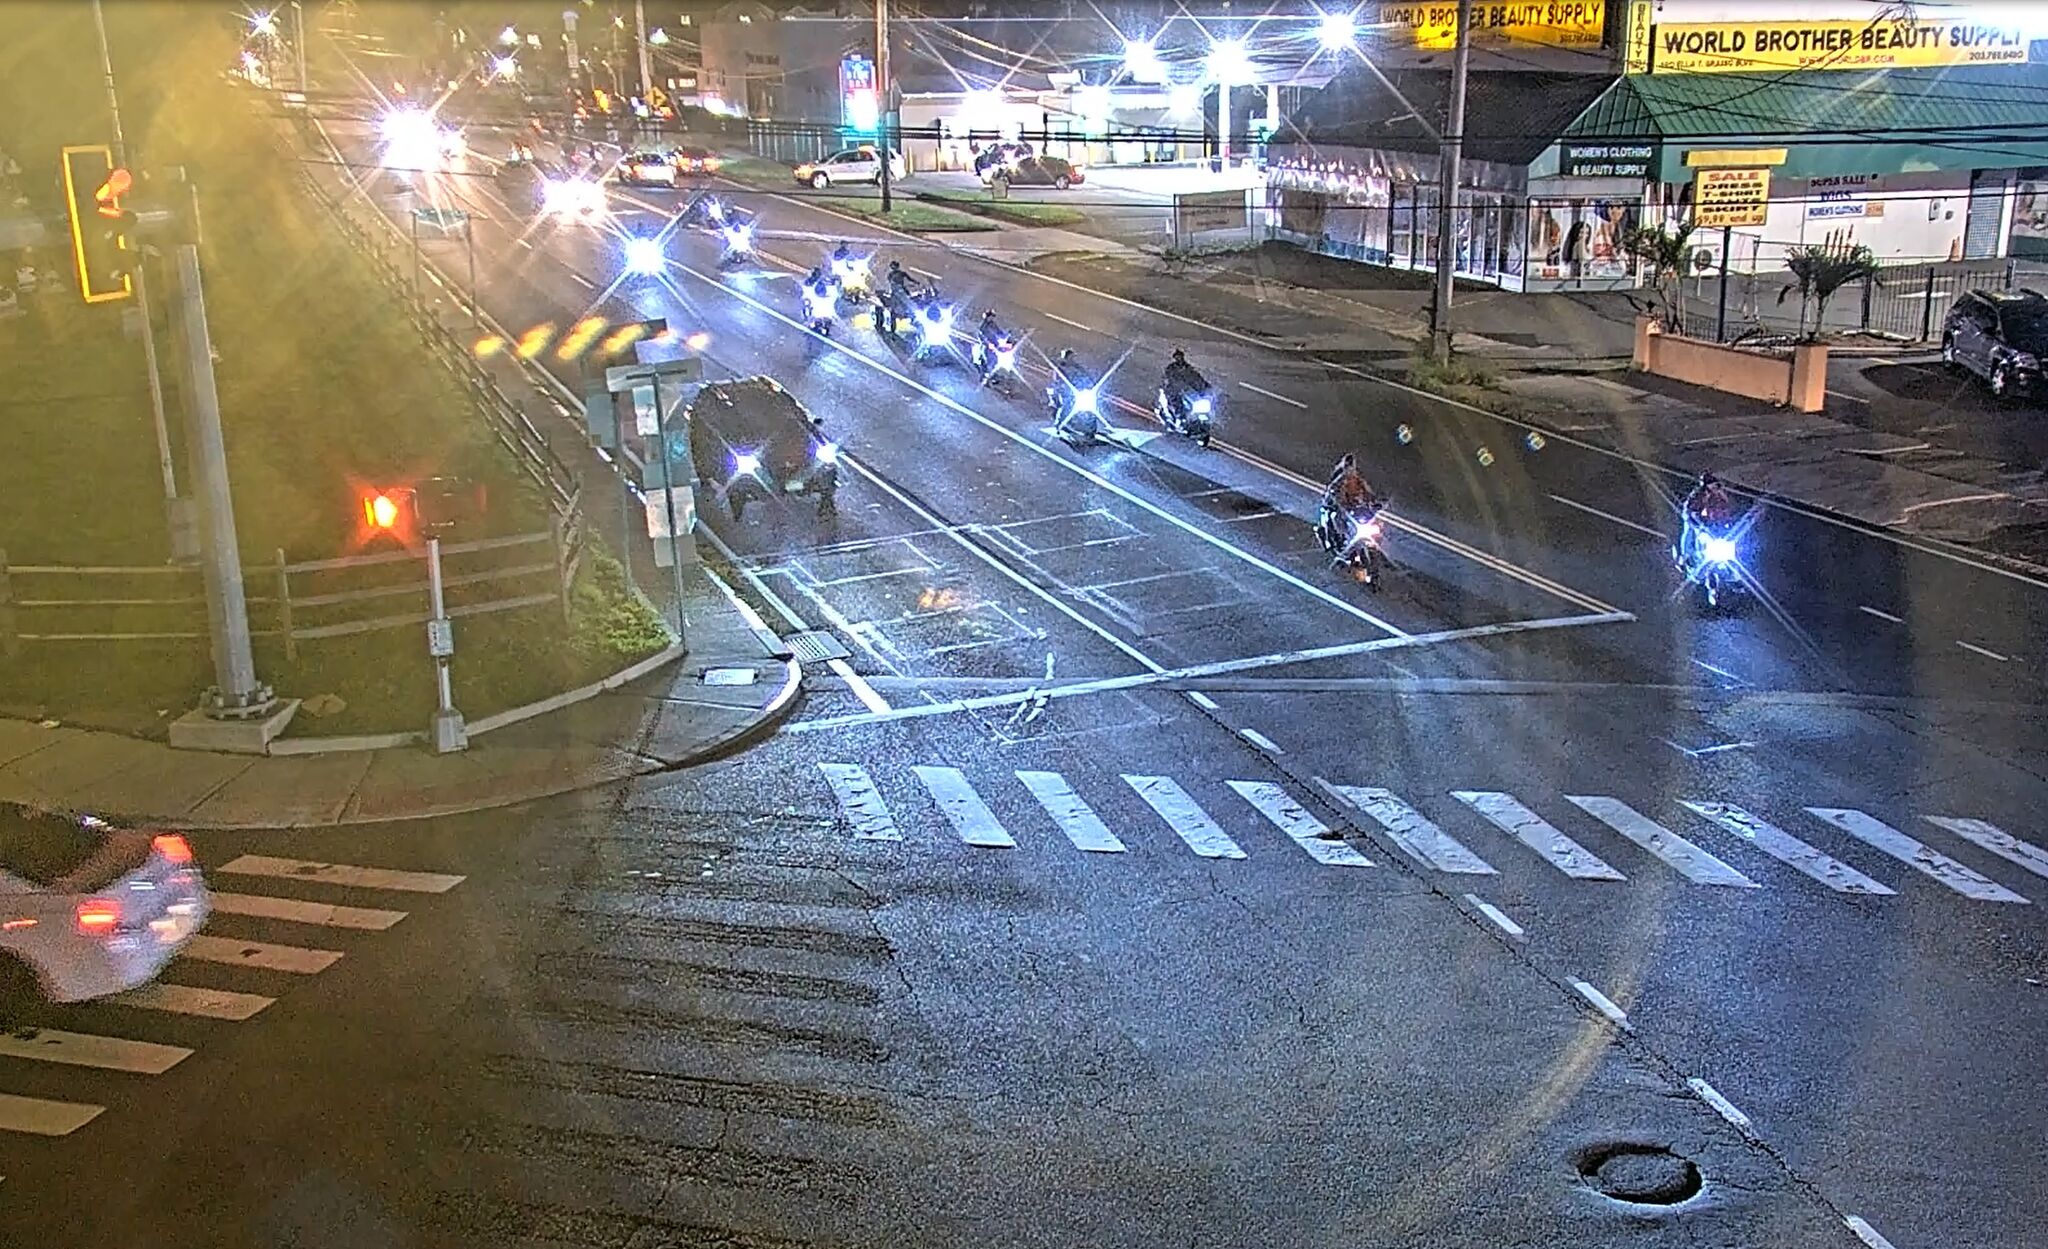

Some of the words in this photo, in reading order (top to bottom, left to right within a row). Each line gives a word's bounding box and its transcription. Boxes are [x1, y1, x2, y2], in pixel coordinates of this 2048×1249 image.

[1430, 7, 1485, 27] BROER
[1490, 5, 1544, 26] BEAUTY
[1547, 3, 1600, 24] SUPPLY
[1664, 30, 1745, 53] WORLD
[1755, 29, 1850, 52] BROTHER
[1861, 27, 1944, 49] BEAUTY
[1569, 147, 1608, 158] WOMEN'S
[1609, 147, 1652, 158] CLOTHING
[1581, 164, 1613, 175] BEAUTY
[1614, 164, 1647, 175] SUPPLY
[1709, 172, 1758, 181] SALE
